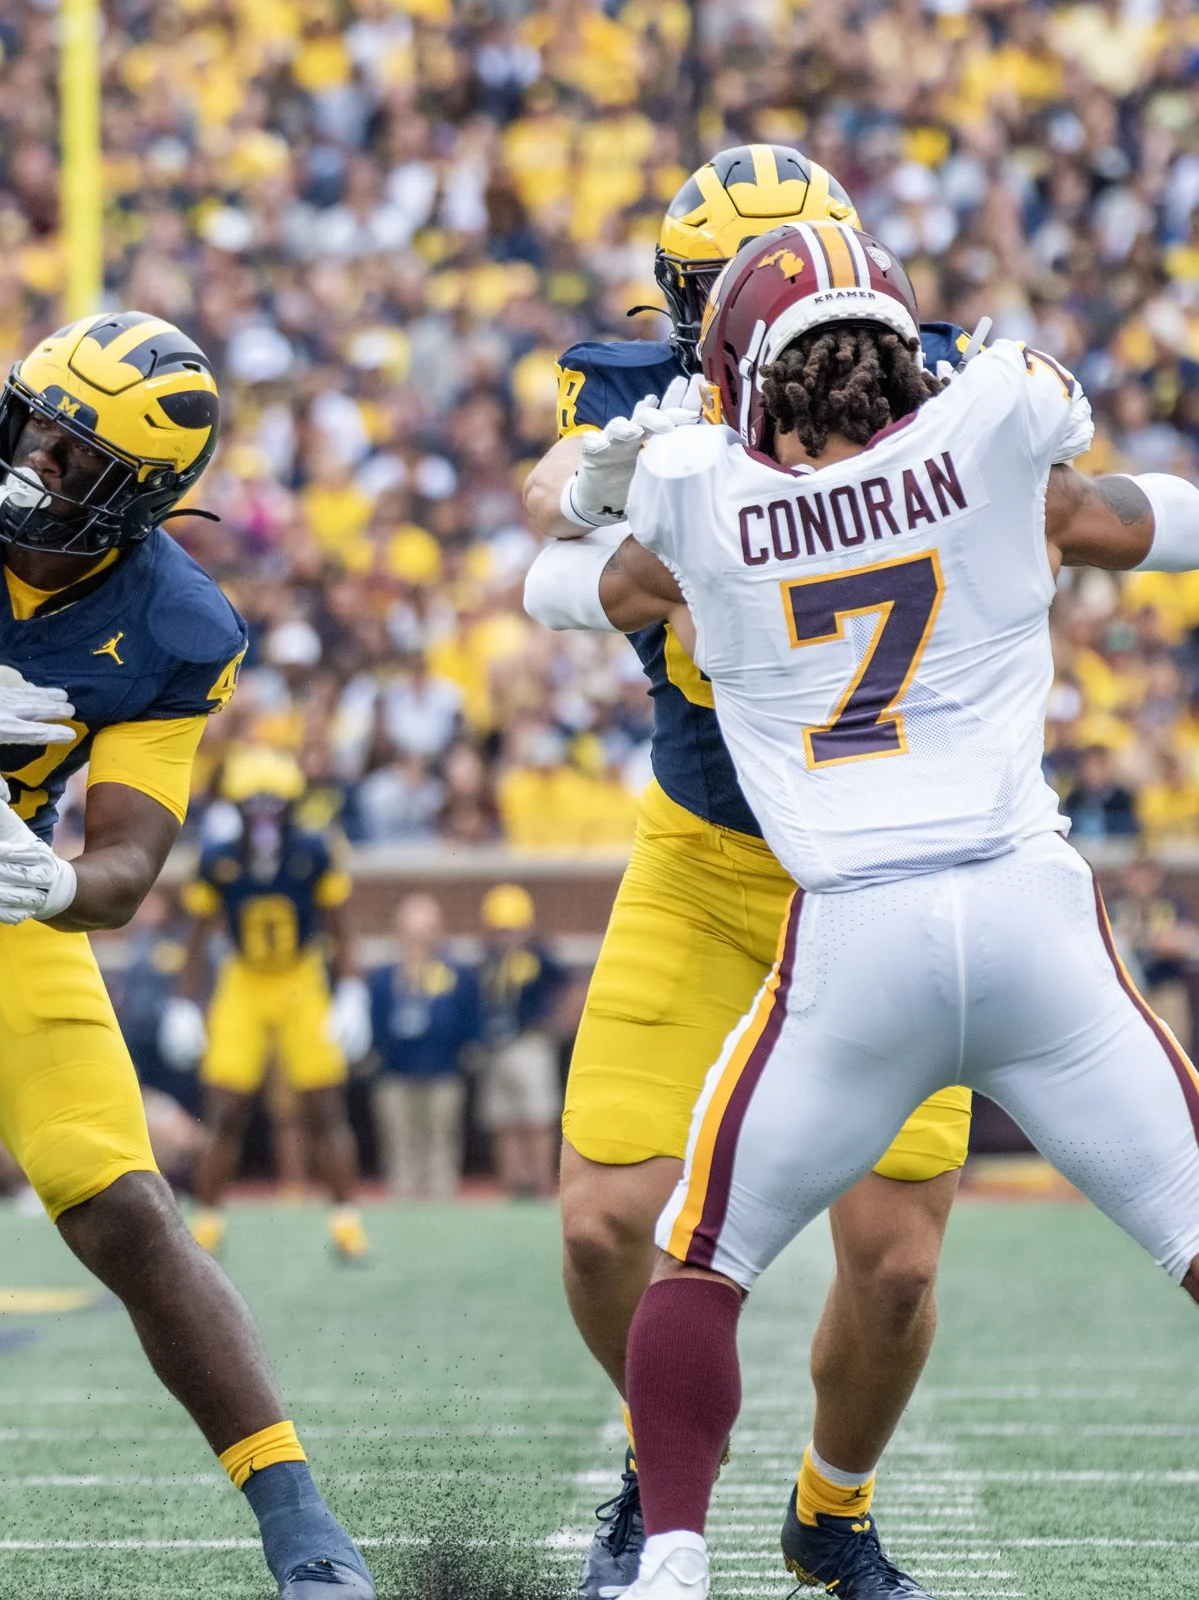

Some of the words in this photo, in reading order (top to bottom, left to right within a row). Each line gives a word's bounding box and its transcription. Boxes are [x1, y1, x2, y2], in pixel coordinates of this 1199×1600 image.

[814, 291, 877, 305] KRAMER
[57, 395, 81, 418] M
[554, 361, 586, 438] 8
[738, 450, 968, 566] CONORAN
[779, 547, 945, 769] 7
